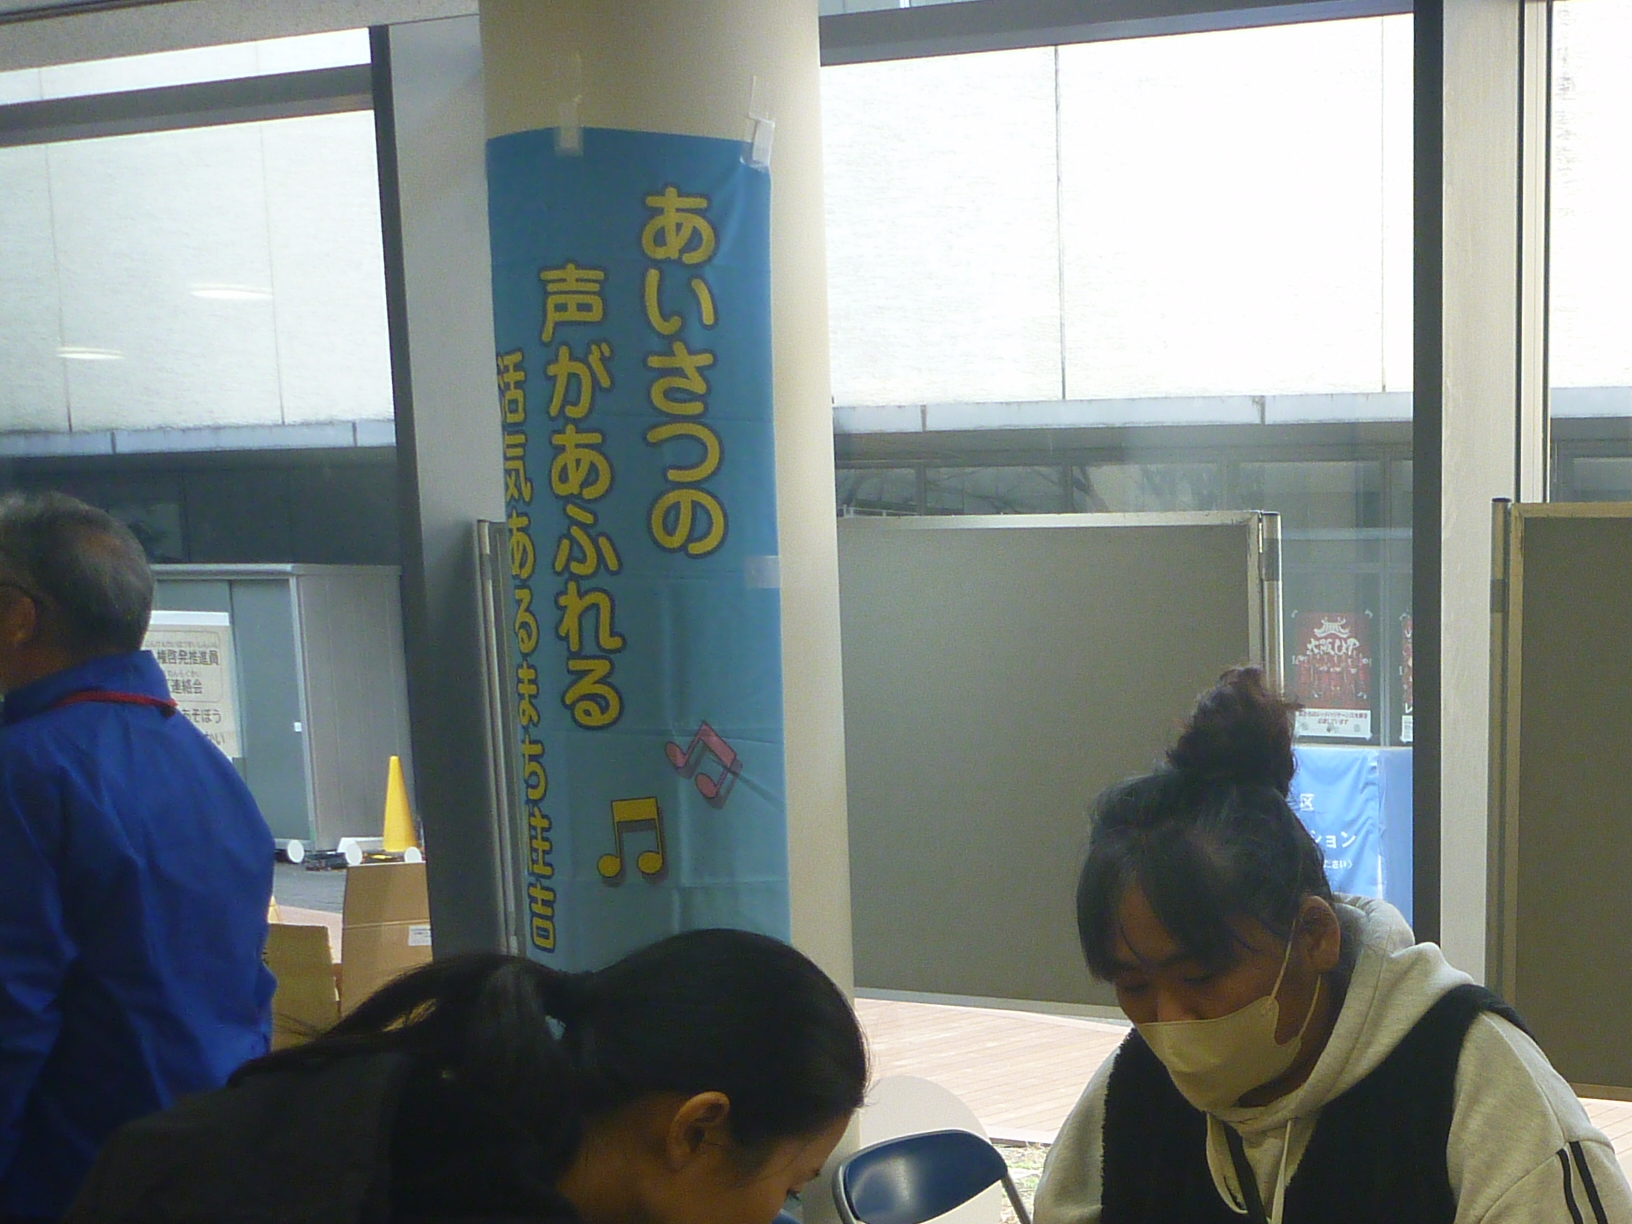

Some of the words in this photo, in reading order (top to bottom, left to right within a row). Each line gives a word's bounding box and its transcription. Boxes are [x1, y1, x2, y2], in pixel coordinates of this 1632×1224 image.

[539, 262, 625, 730] 声があふれる
[641, 186, 727, 557] あいさつの
